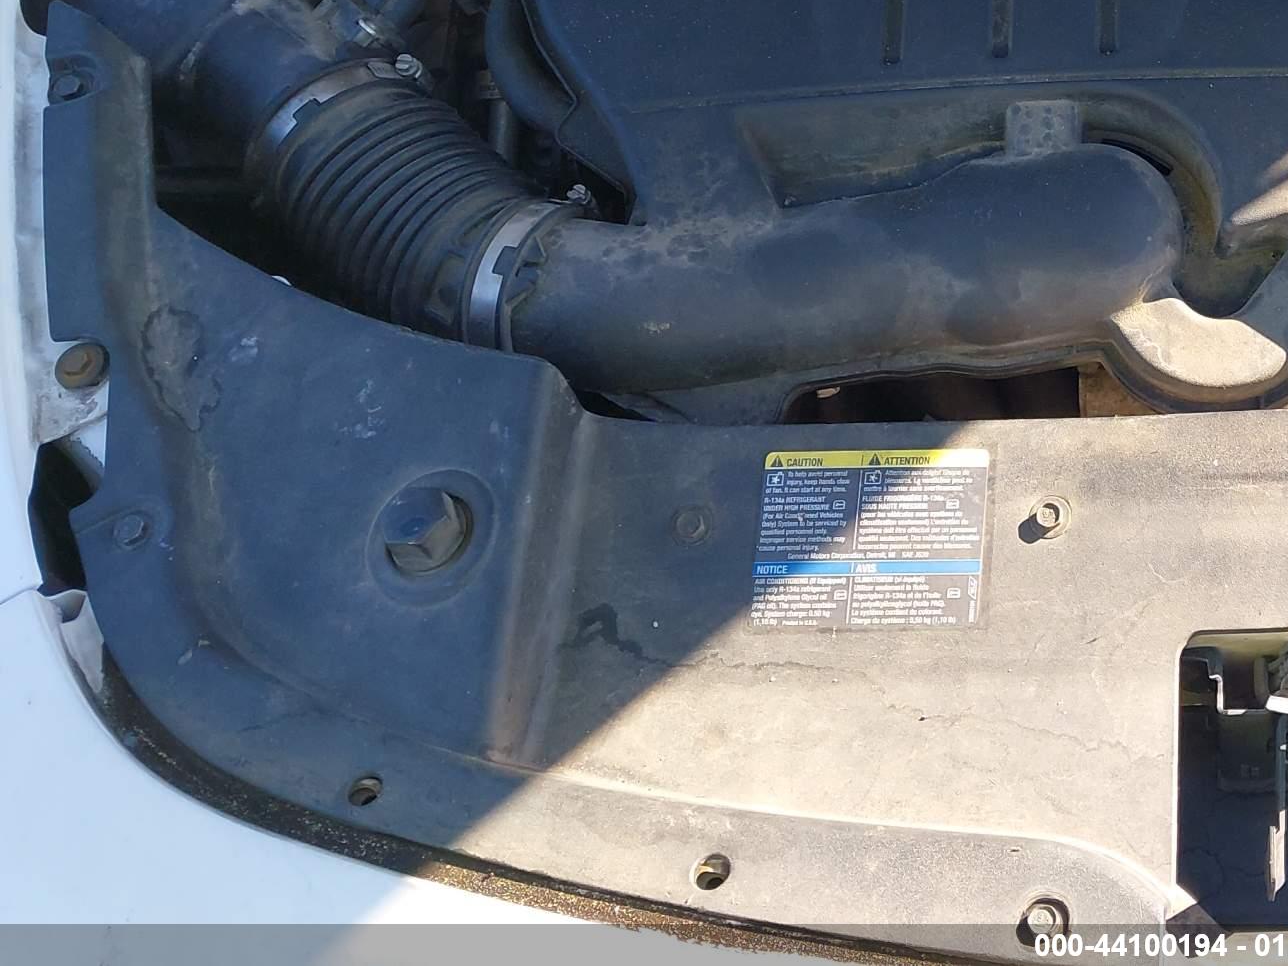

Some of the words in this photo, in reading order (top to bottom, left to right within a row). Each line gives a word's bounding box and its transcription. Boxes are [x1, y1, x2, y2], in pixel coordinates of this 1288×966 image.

[786, 458, 823, 466] CAUTION
[884, 456, 930, 465] ATTENTION
[757, 566, 788, 574] NOTICE
[856, 564, 877, 572] AVIS
